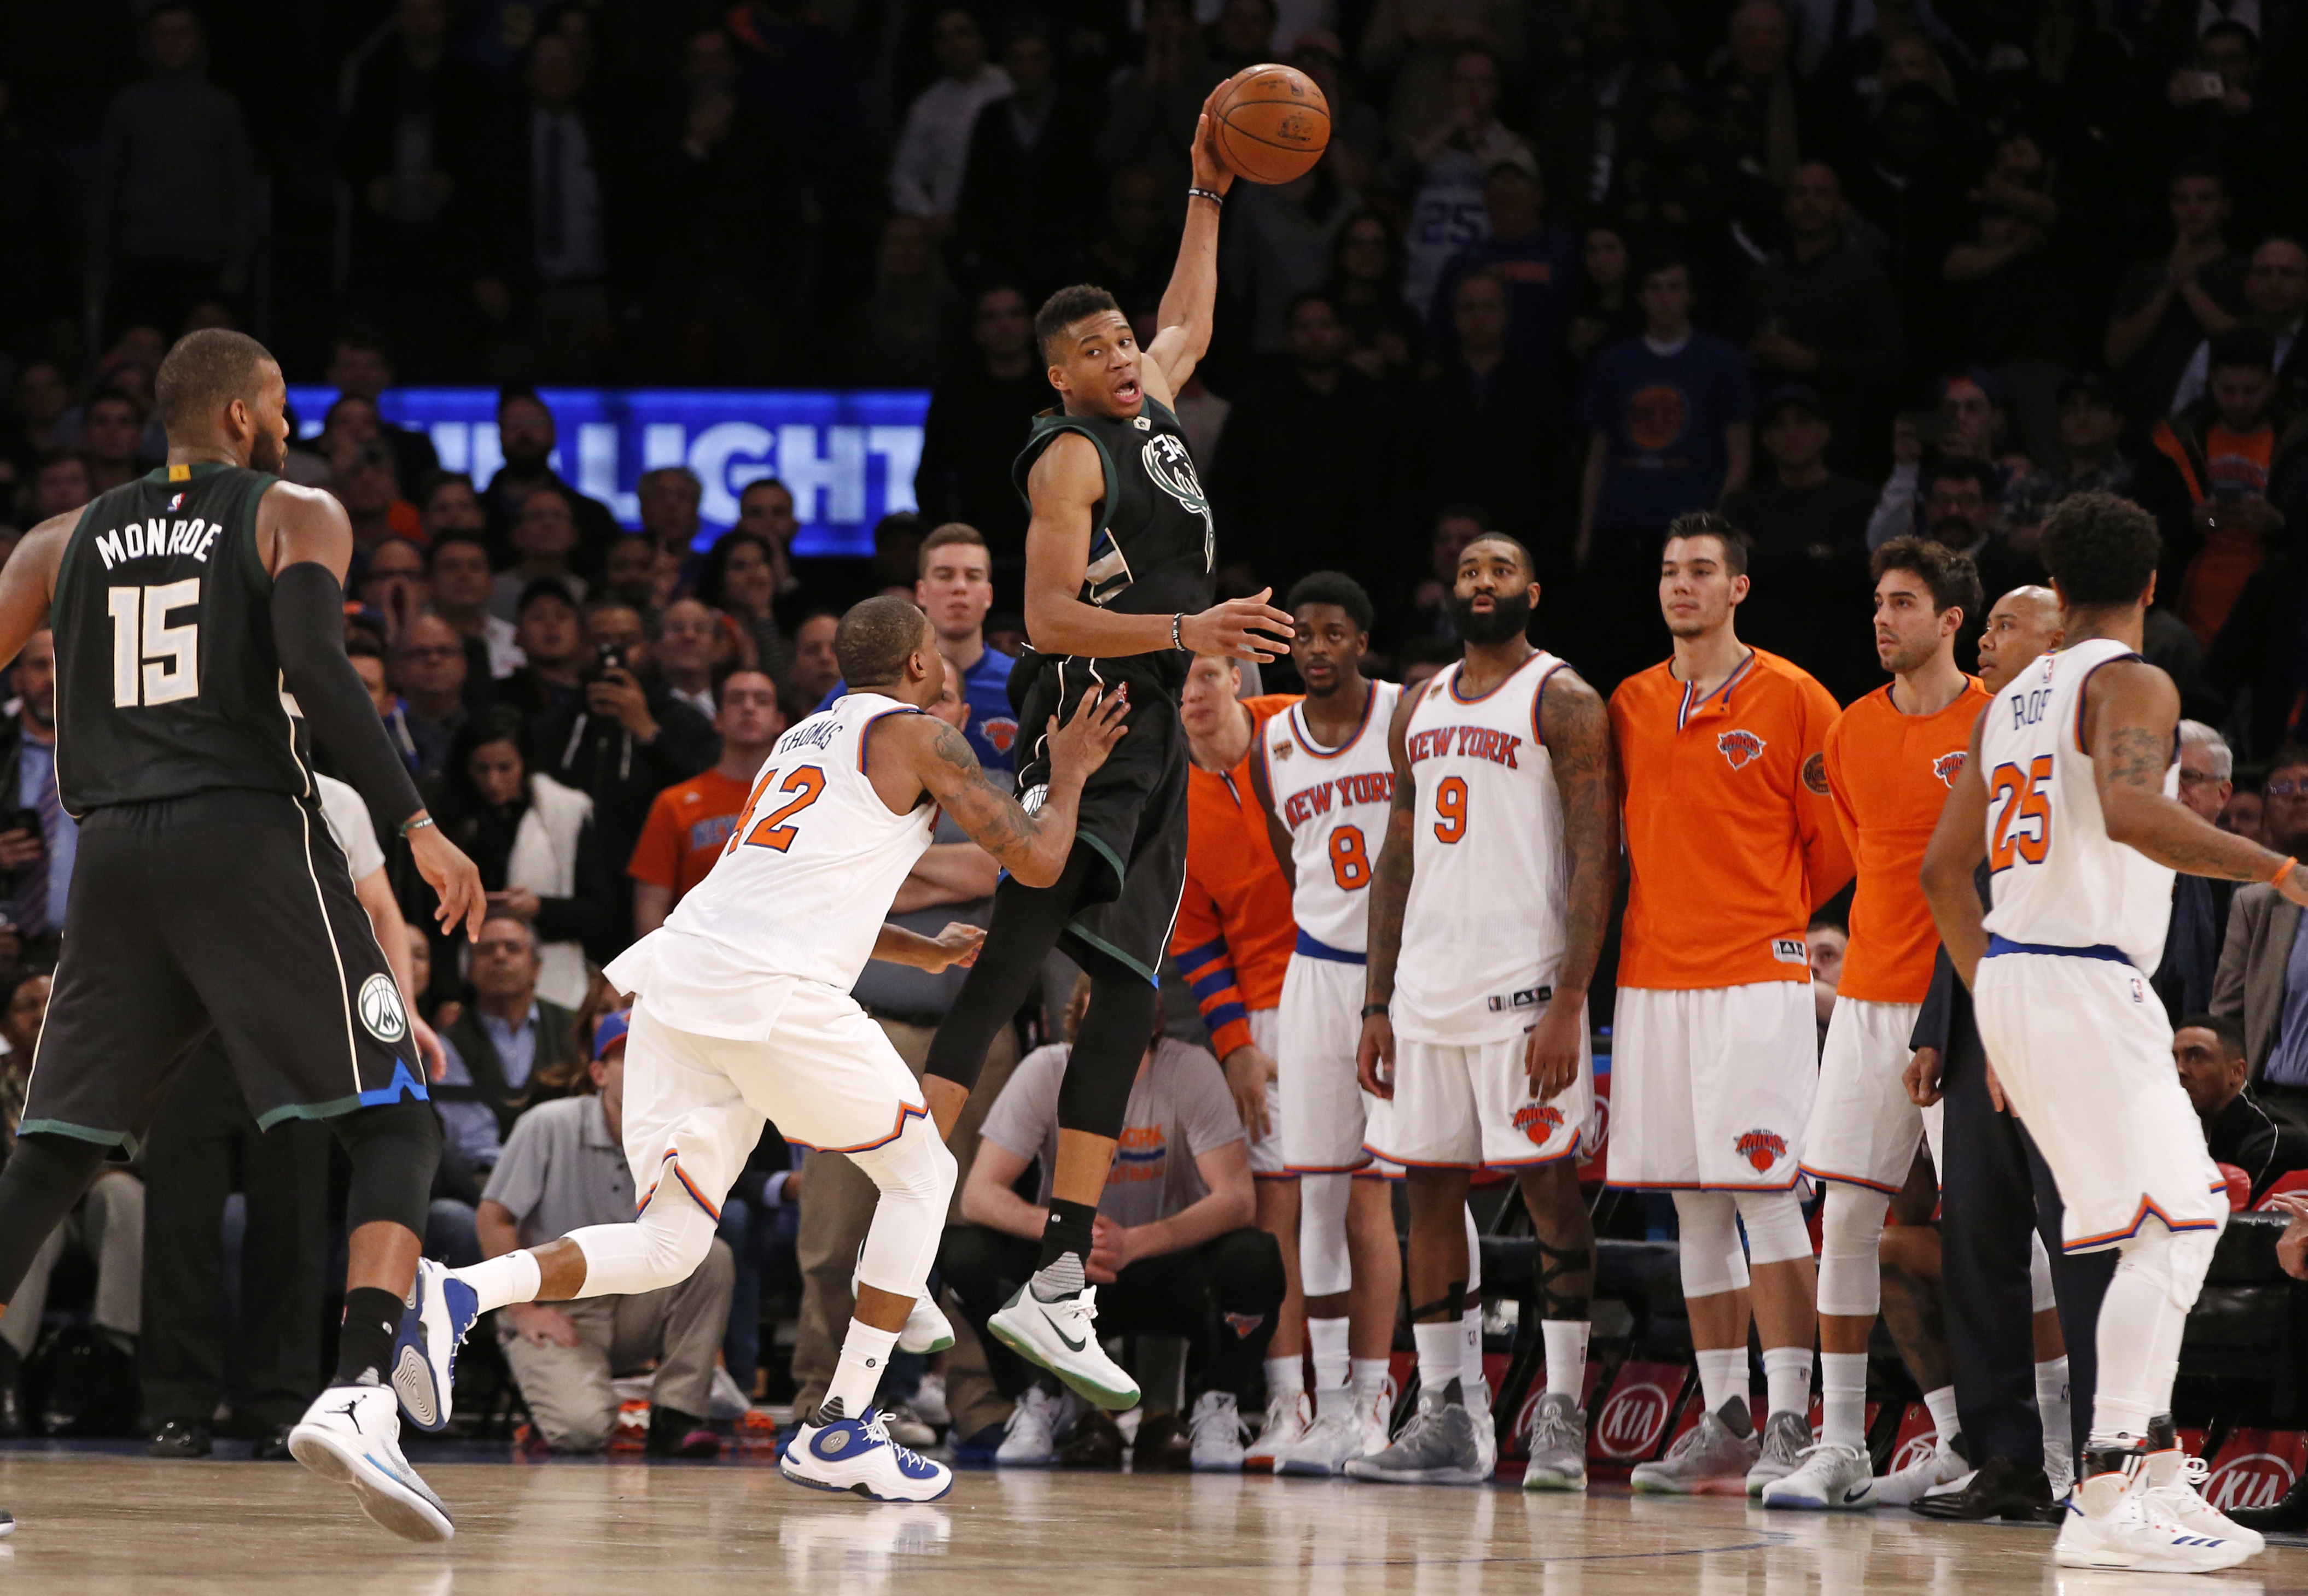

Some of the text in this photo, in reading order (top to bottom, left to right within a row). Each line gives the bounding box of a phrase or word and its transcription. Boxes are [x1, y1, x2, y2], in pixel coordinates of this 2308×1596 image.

[95, 518, 223, 570] MONROE
[108, 577, 200, 708] 15
[779, 720, 843, 755] THOMAS
[1409, 726, 1522, 769] NEW YORK
[726, 764, 826, 857] 42
[1285, 781, 1332, 832] NEW
[1434, 776, 1468, 844] 9
[1990, 753, 2054, 875] 25
[1328, 825, 1372, 891] 8
[1606, 1398, 1656, 1442] KIA
[2213, 1469, 2279, 1510] KIA
